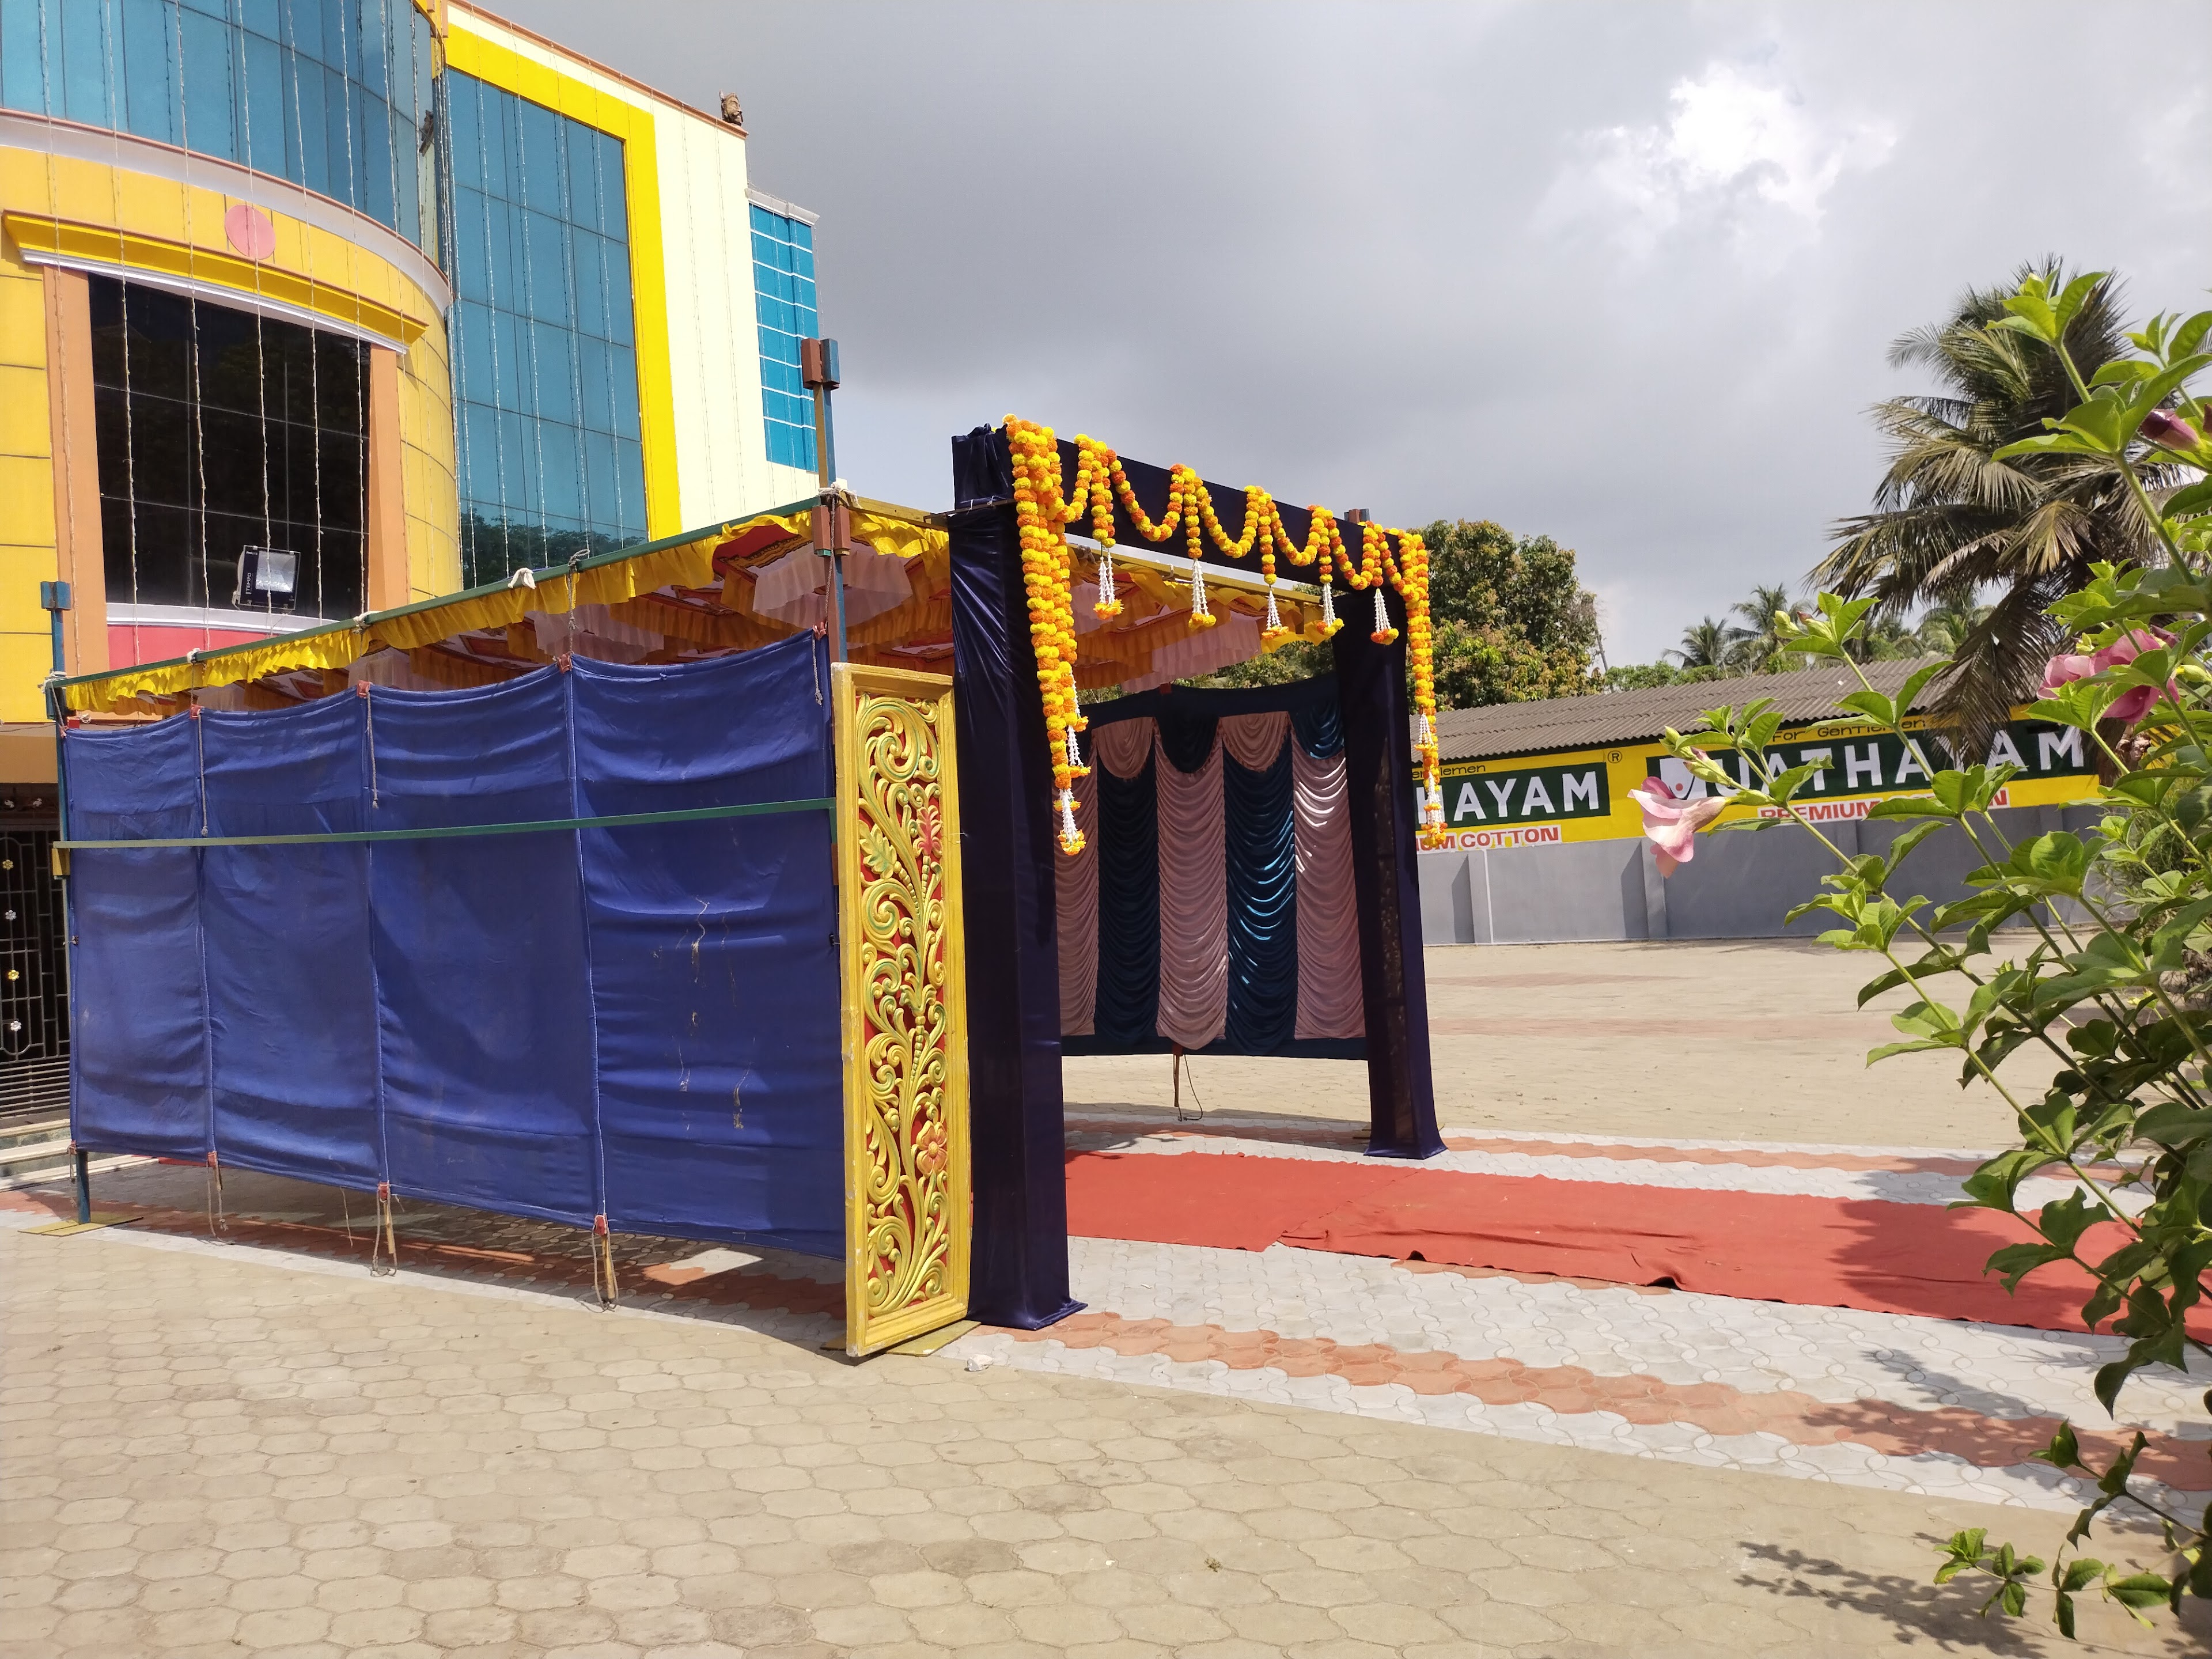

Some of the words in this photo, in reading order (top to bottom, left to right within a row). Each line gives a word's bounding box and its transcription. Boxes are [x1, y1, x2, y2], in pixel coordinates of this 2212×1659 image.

[1772, 731, 1805, 743] For
[1817, 719, 1926, 738] Gentleen
[1461, 827, 1559, 848] COTTON
